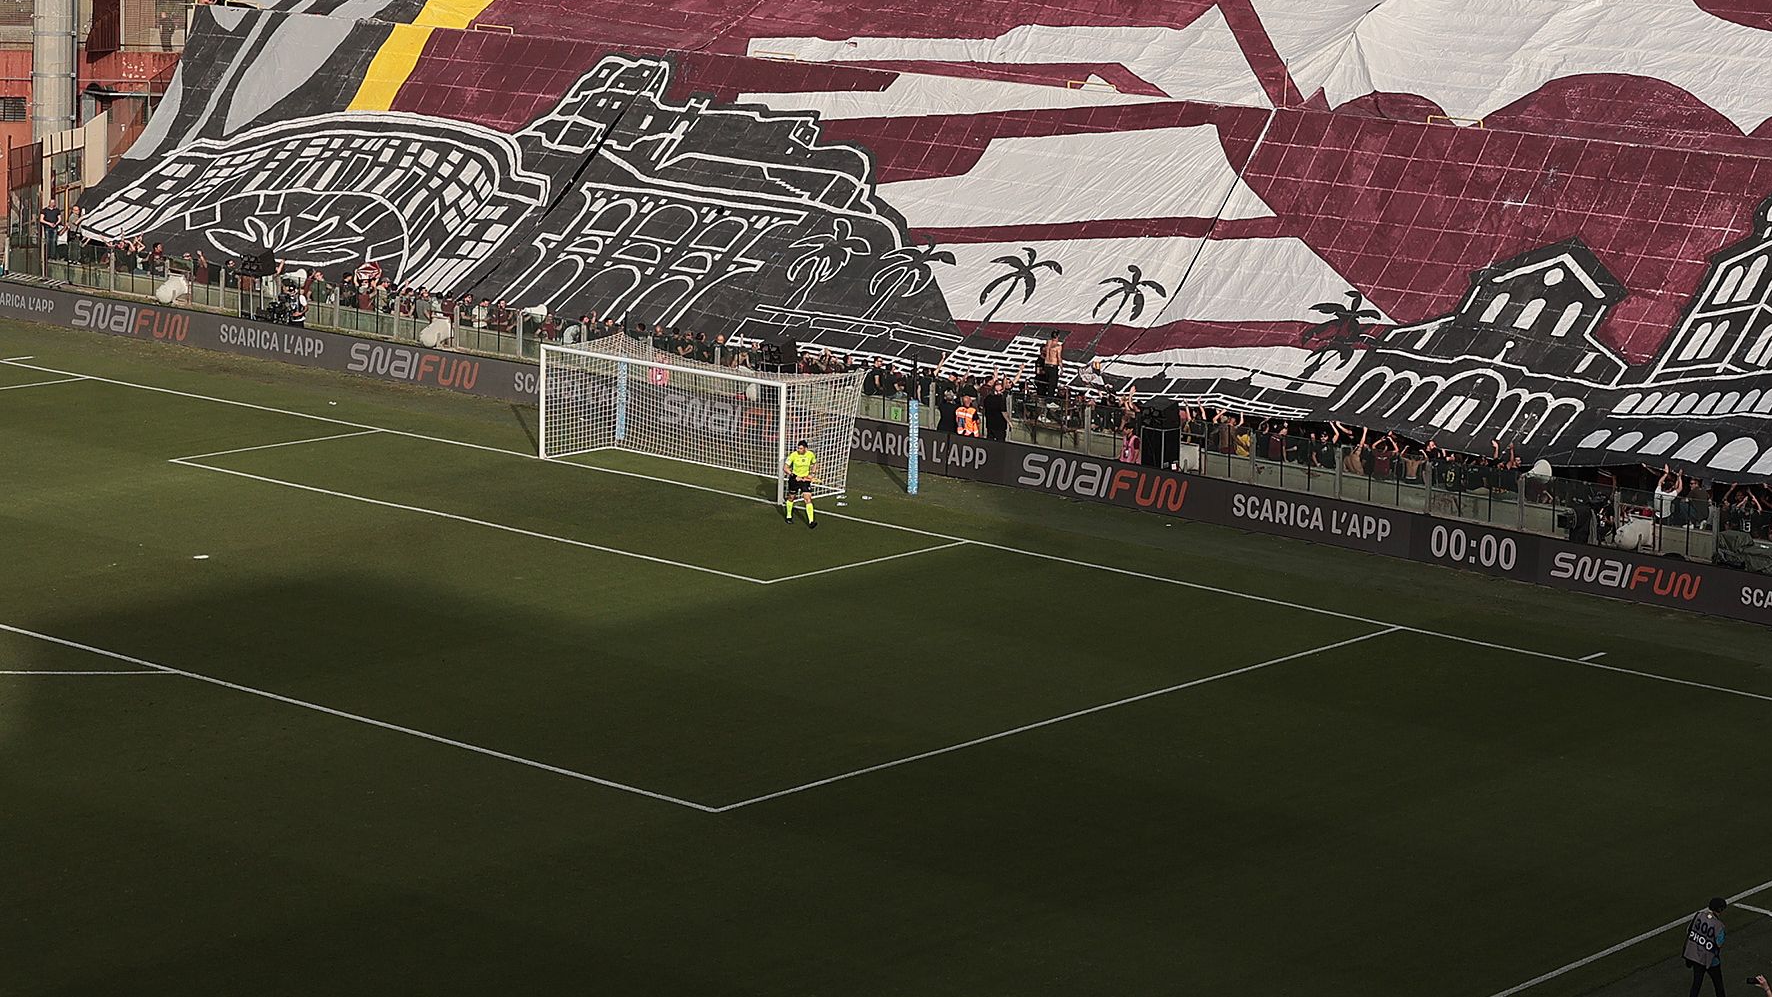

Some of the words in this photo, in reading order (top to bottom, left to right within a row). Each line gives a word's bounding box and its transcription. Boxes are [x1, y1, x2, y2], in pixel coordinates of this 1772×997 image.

[219, 323, 279, 352] SCARICA
[1232, 493, 1324, 532] SCARICA
[1430, 524, 1517, 571] 00:00
[1694, 919, 1715, 938] 300
